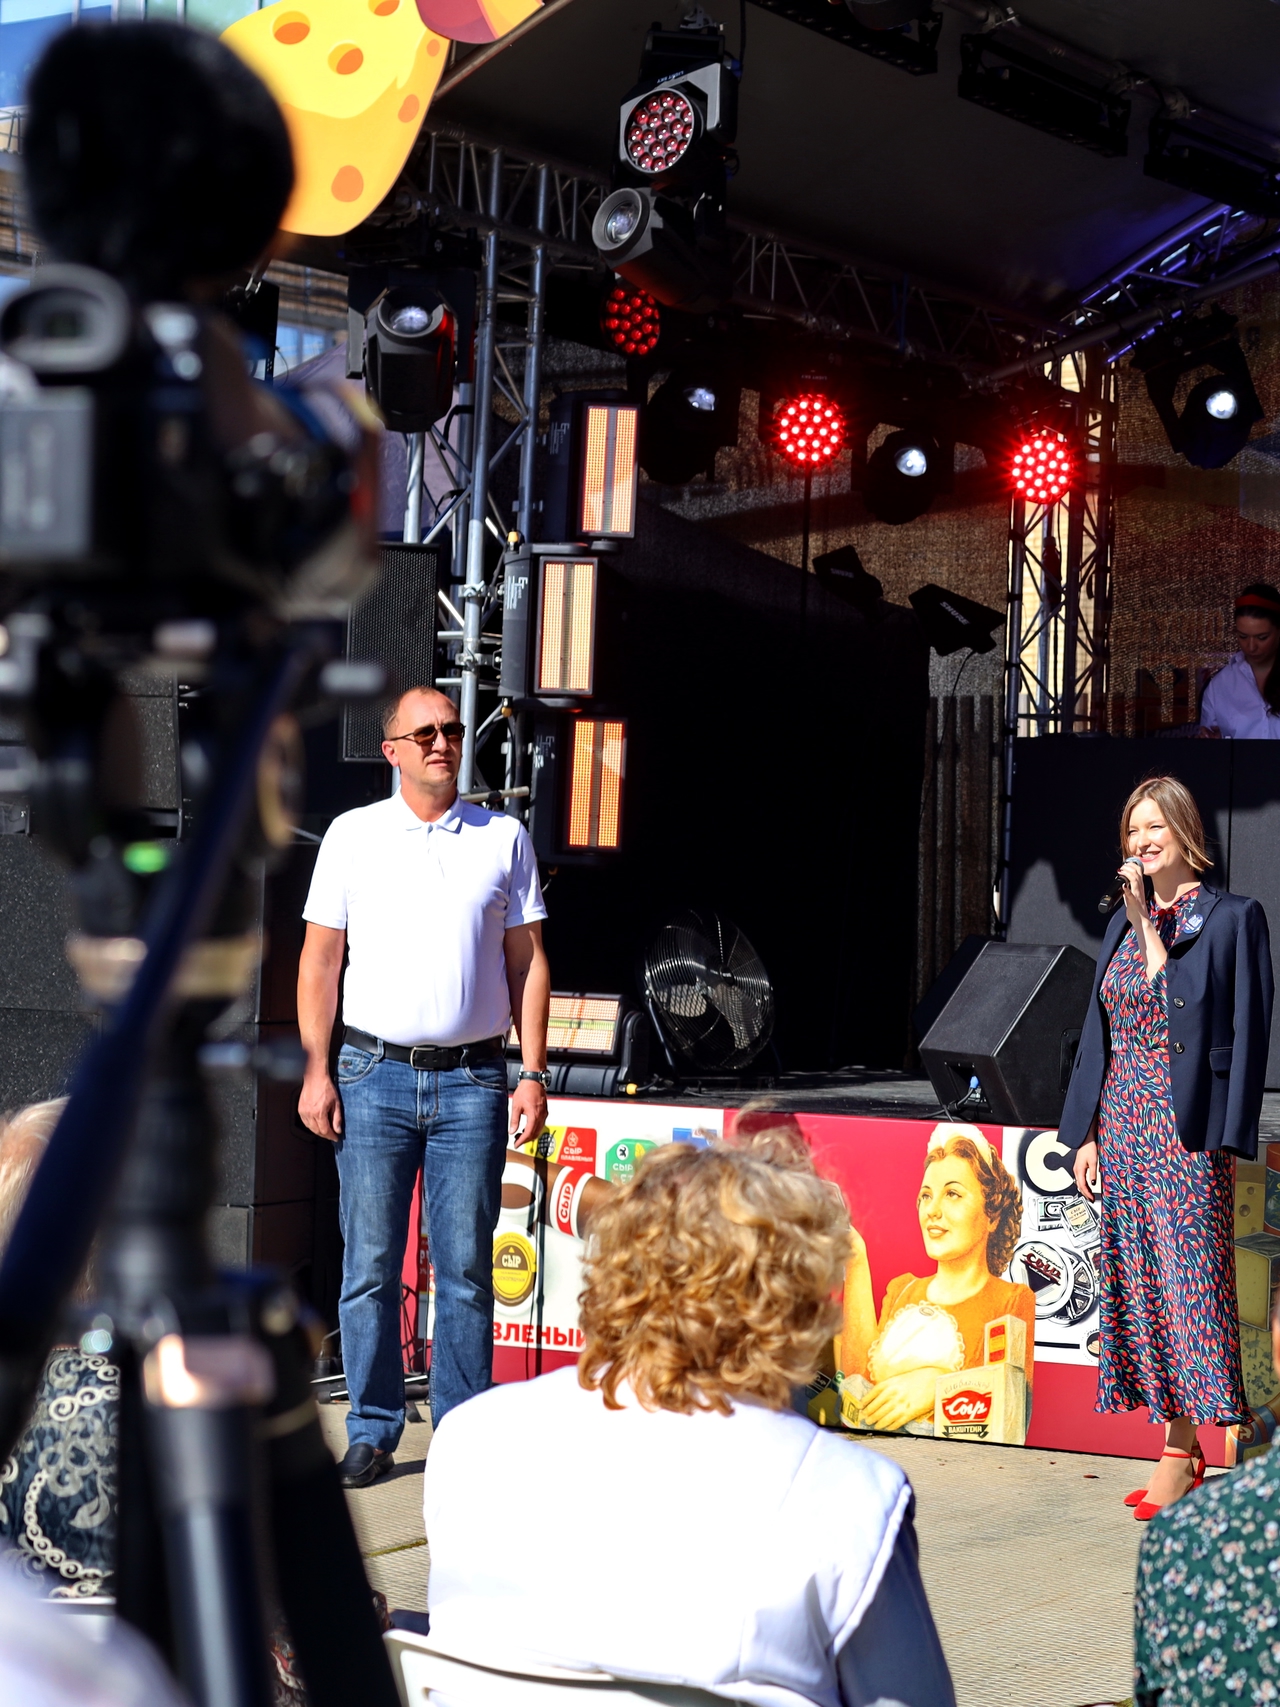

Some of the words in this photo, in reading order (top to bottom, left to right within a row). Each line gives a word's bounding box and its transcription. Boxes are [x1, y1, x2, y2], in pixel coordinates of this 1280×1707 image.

[939, 601, 971, 626] SHURE
[563, 1146, 583, 1155] СЫР
[560, 1184, 574, 1220] СЫР
[501, 1254, 522, 1268] СЫР
